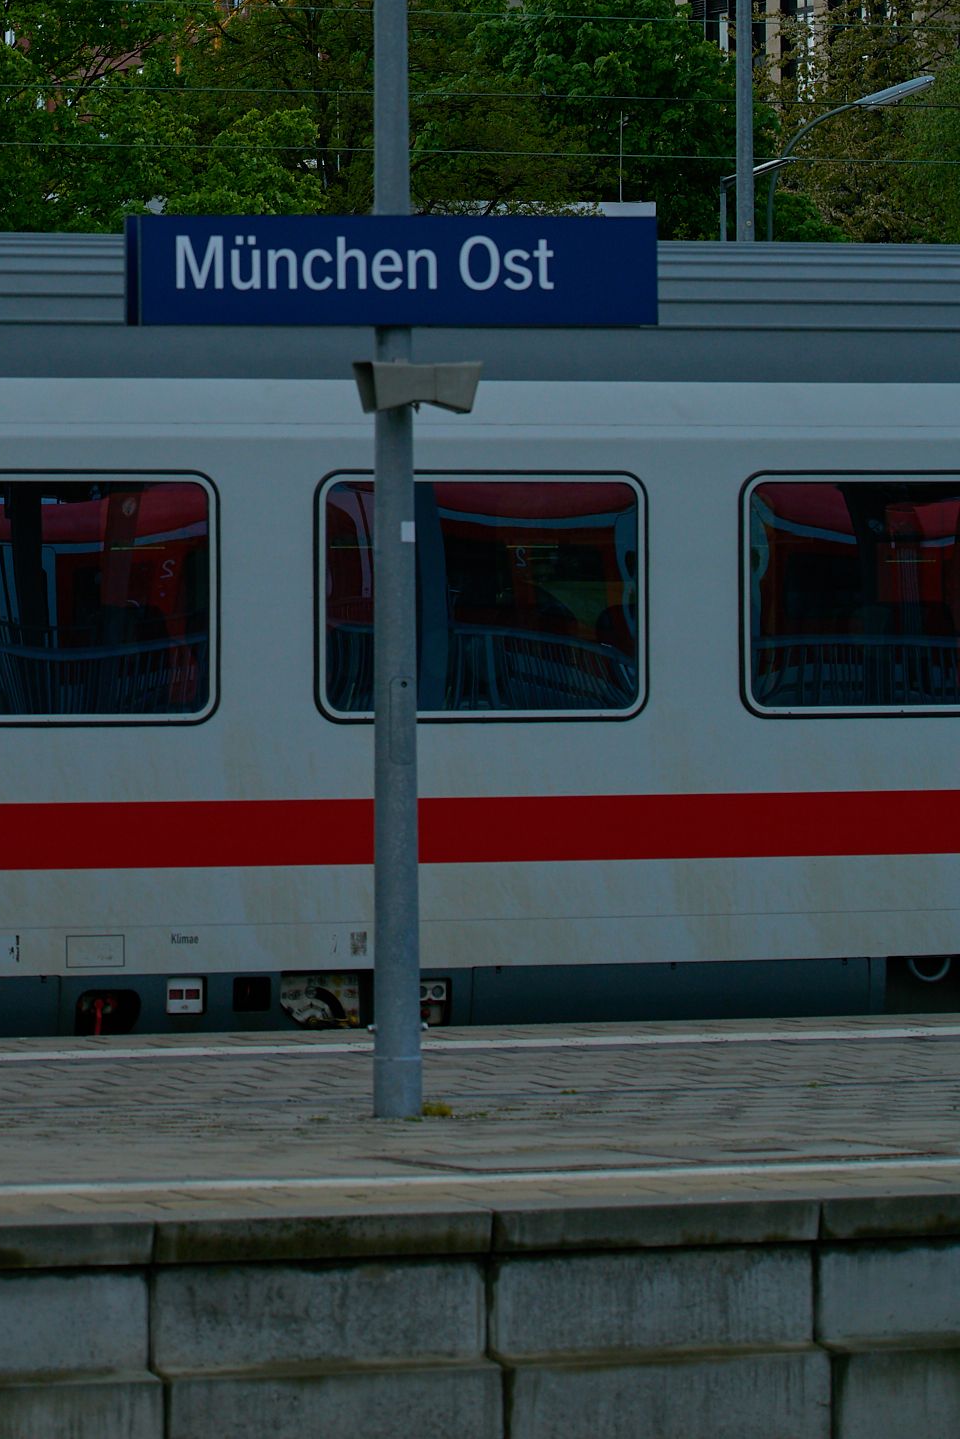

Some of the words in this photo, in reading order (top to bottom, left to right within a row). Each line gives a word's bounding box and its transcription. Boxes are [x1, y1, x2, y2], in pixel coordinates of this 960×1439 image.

[174, 234, 439, 291] München
[458, 234, 556, 292] Ost
[170, 933, 199, 944] Klimae
